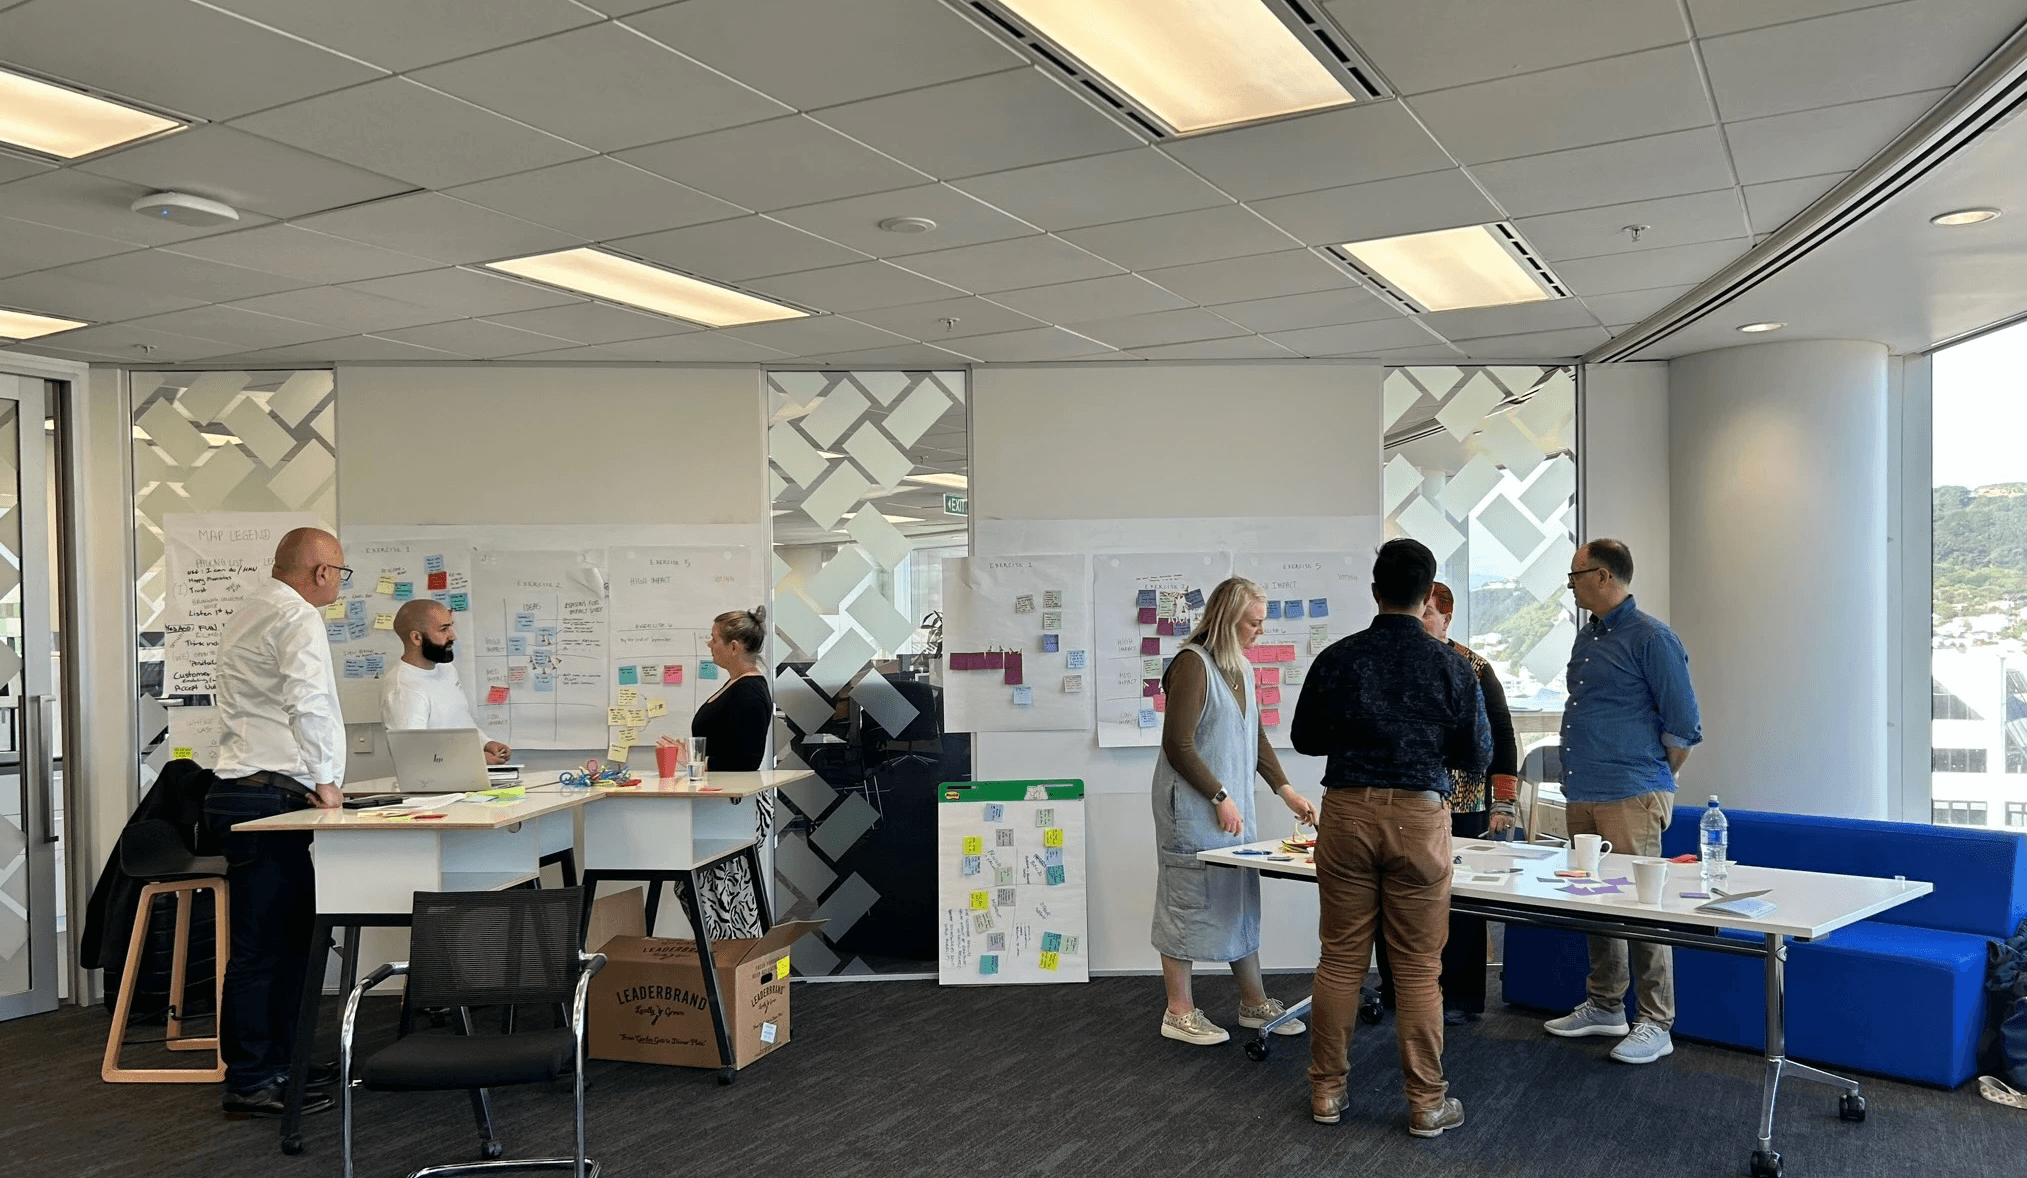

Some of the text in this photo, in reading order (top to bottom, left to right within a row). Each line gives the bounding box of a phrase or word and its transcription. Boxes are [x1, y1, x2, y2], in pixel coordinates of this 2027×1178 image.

[951, 498, 968, 512] EXIT
[198, 528, 271, 542] MAP LEGEND
[229, 559, 244, 568] LIST
[684, 559, 691, 567] 5
[555, 581, 564, 589] 2
[630, 576, 672, 586] HIGH IMPACT
[1272, 581, 1297, 590] IMPACT
[189, 586, 207, 594] Trust
[522, 602, 542, 612] IDEAS
[188, 609, 213, 617] Listen
[1117, 638, 1133, 646] HIGH
[173, 671, 210, 679] Customer
[174, 684, 198, 692] Accept
[642, 946, 699, 954] LEADERBR
[616, 985, 708, 1011] LEADERBRAND
[751, 985, 784, 1008] LEADERBRAND
